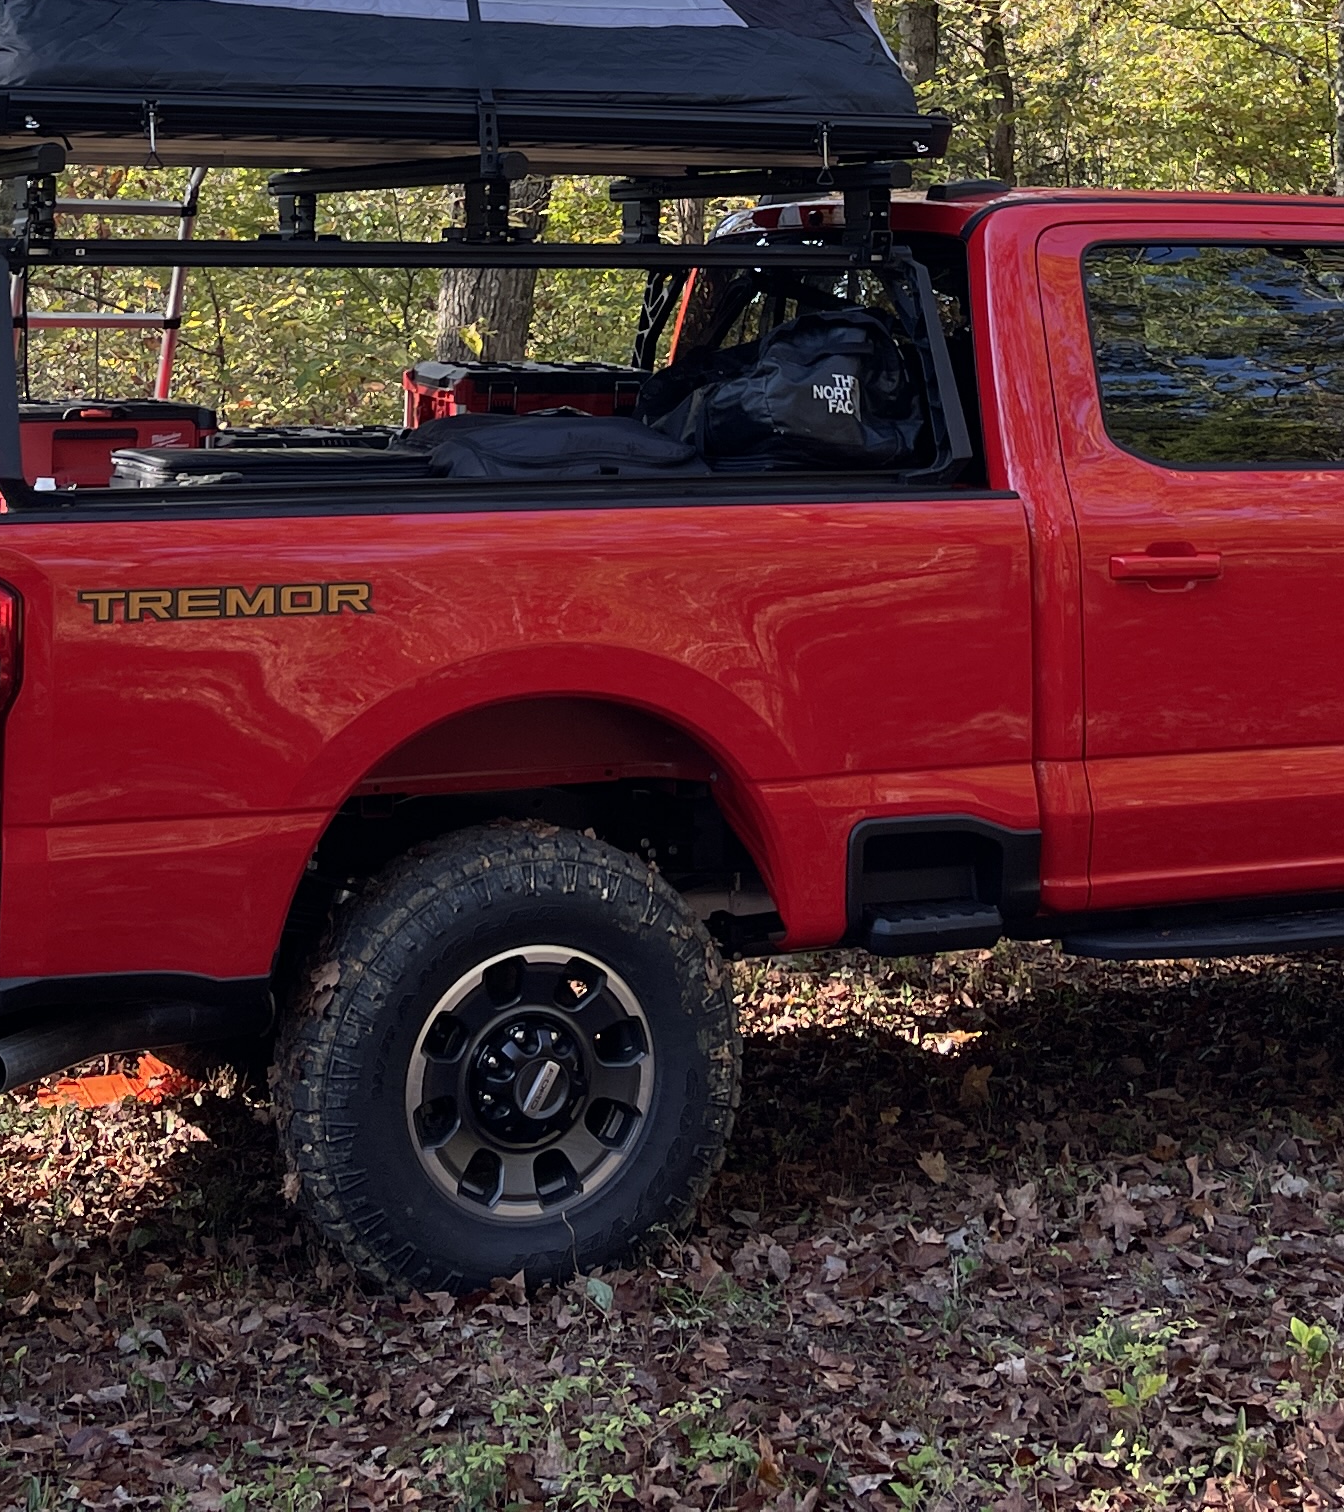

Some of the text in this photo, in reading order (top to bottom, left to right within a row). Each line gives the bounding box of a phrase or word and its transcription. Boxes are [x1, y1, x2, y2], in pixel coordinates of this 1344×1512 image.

[813, 385, 852, 400] NORT
[829, 399, 855, 415] FAC
[79, 583, 373, 623] TREMOR
